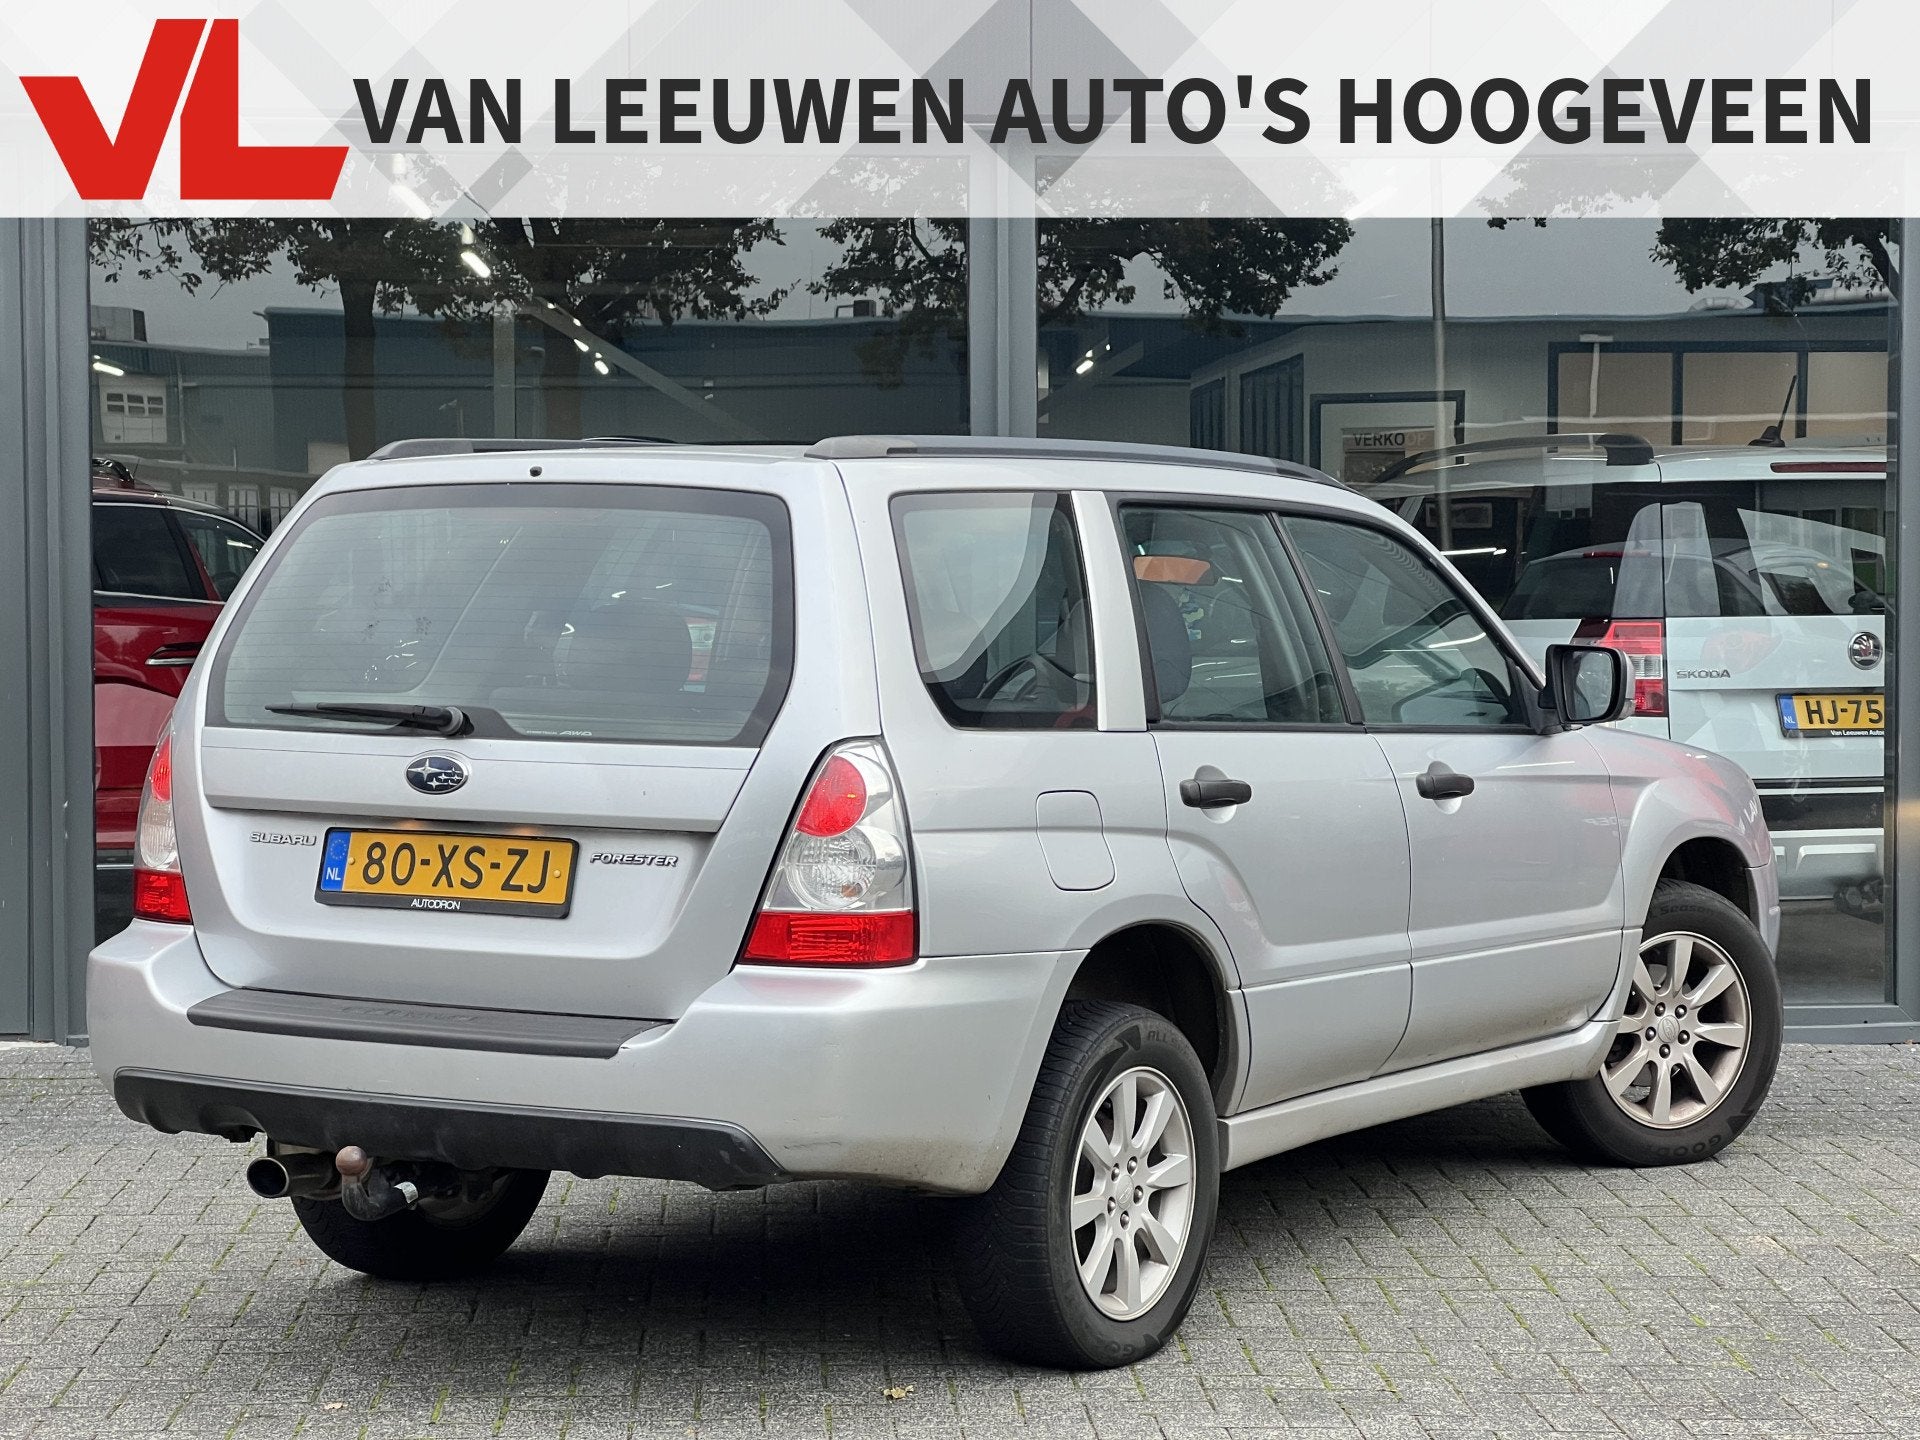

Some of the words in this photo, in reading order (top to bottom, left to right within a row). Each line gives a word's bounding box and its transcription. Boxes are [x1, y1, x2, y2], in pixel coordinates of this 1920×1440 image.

[1676, 669, 1731, 679] SKODA
[1784, 715, 1796, 724] NL
[1804, 700, 1884, 725] HJ-75
[250, 831, 317, 847] SUBARU
[590, 852, 679, 868] FORESTER
[325, 867, 342, 880] NL
[362, 841, 551, 894] 80-XS-ZJ
[411, 898, 461, 910] AUTODRON
